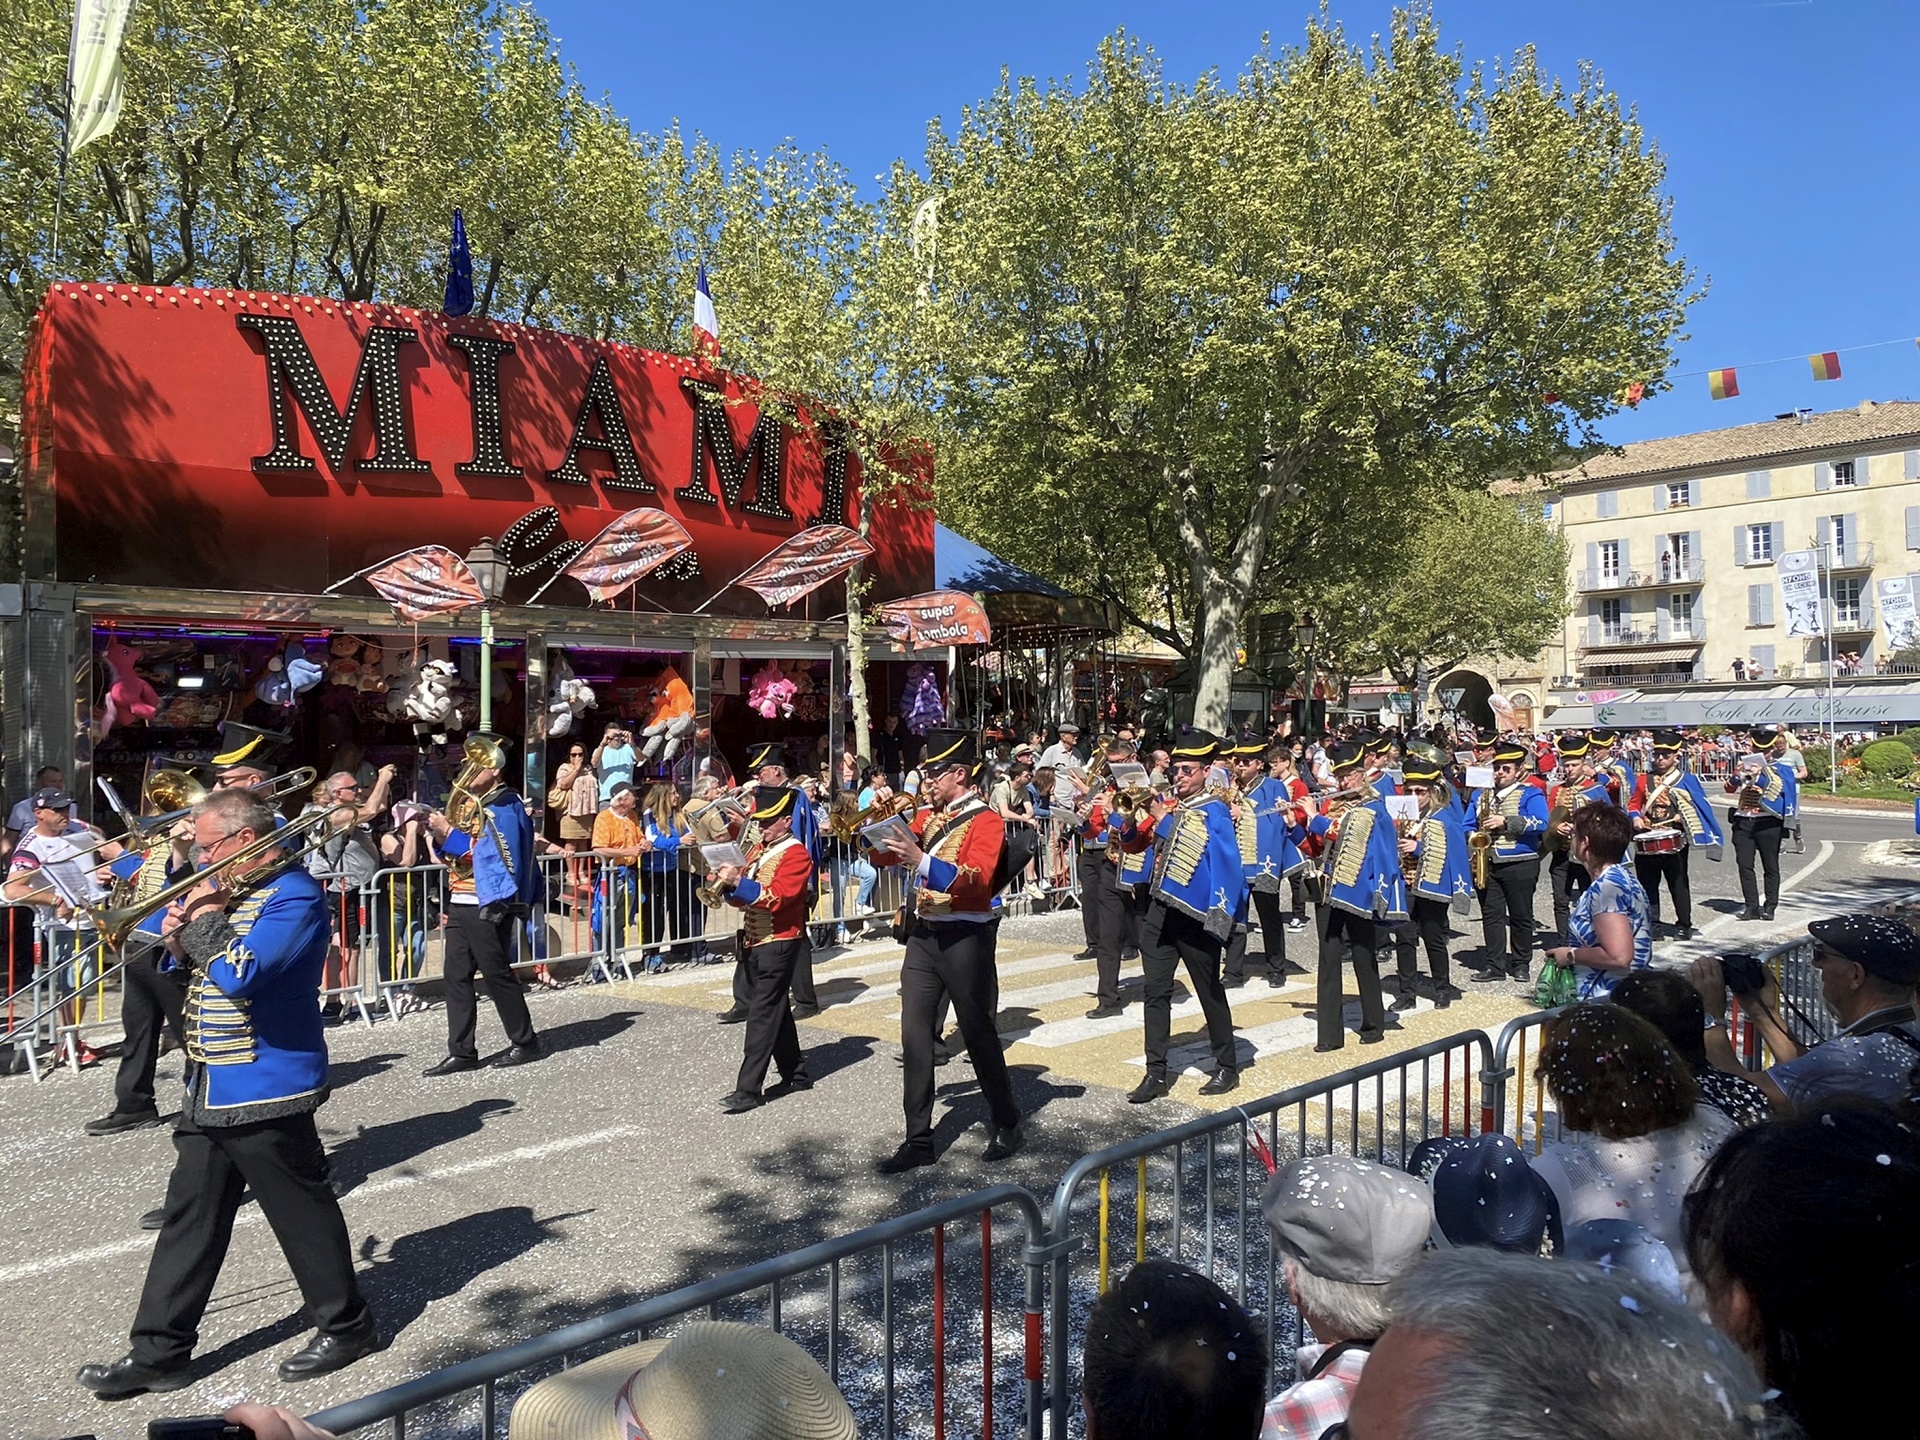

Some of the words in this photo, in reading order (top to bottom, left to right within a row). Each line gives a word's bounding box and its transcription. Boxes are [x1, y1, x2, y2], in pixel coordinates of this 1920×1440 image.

[235, 312, 851, 527] MIAMI
[612, 530, 641, 557] salle
[1782, 572, 1811, 584] NYONS
[921, 605, 955, 621] super
[917, 622, 968, 641] tombola
[1753, 703, 1773, 717] de
[1782, 702, 1802, 717] la
[1811, 700, 1891, 716] Bourse
